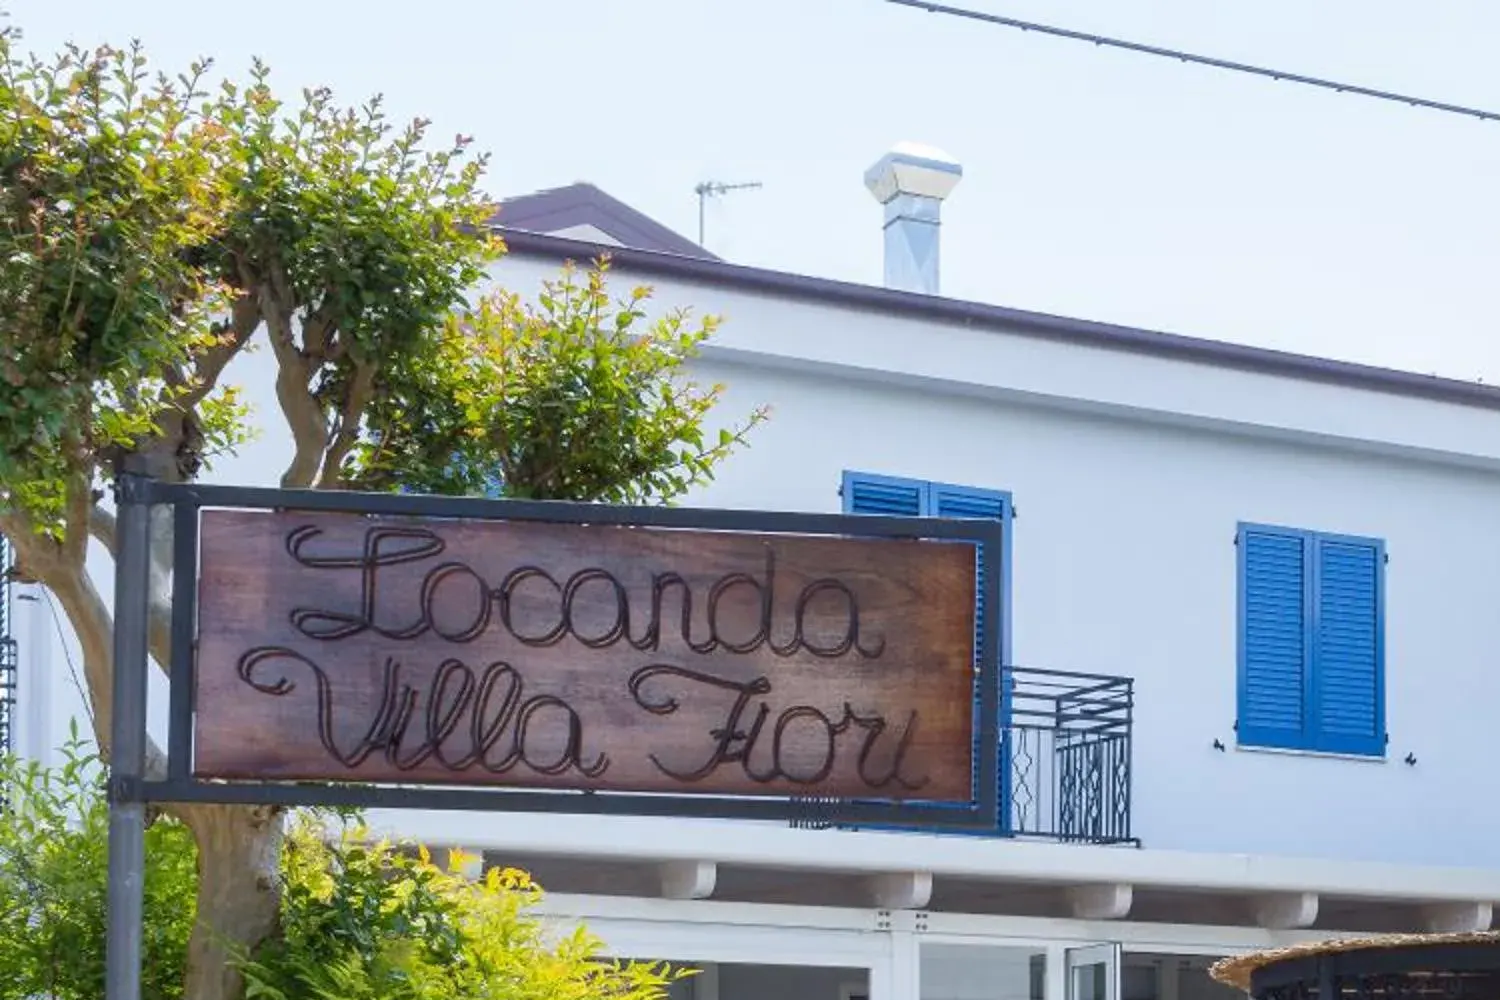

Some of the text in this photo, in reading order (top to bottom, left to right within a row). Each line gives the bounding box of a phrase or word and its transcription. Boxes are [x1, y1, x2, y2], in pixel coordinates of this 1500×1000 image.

[286, 524, 885, 659] Locanda
[237, 646, 930, 790] Villa Fiori
